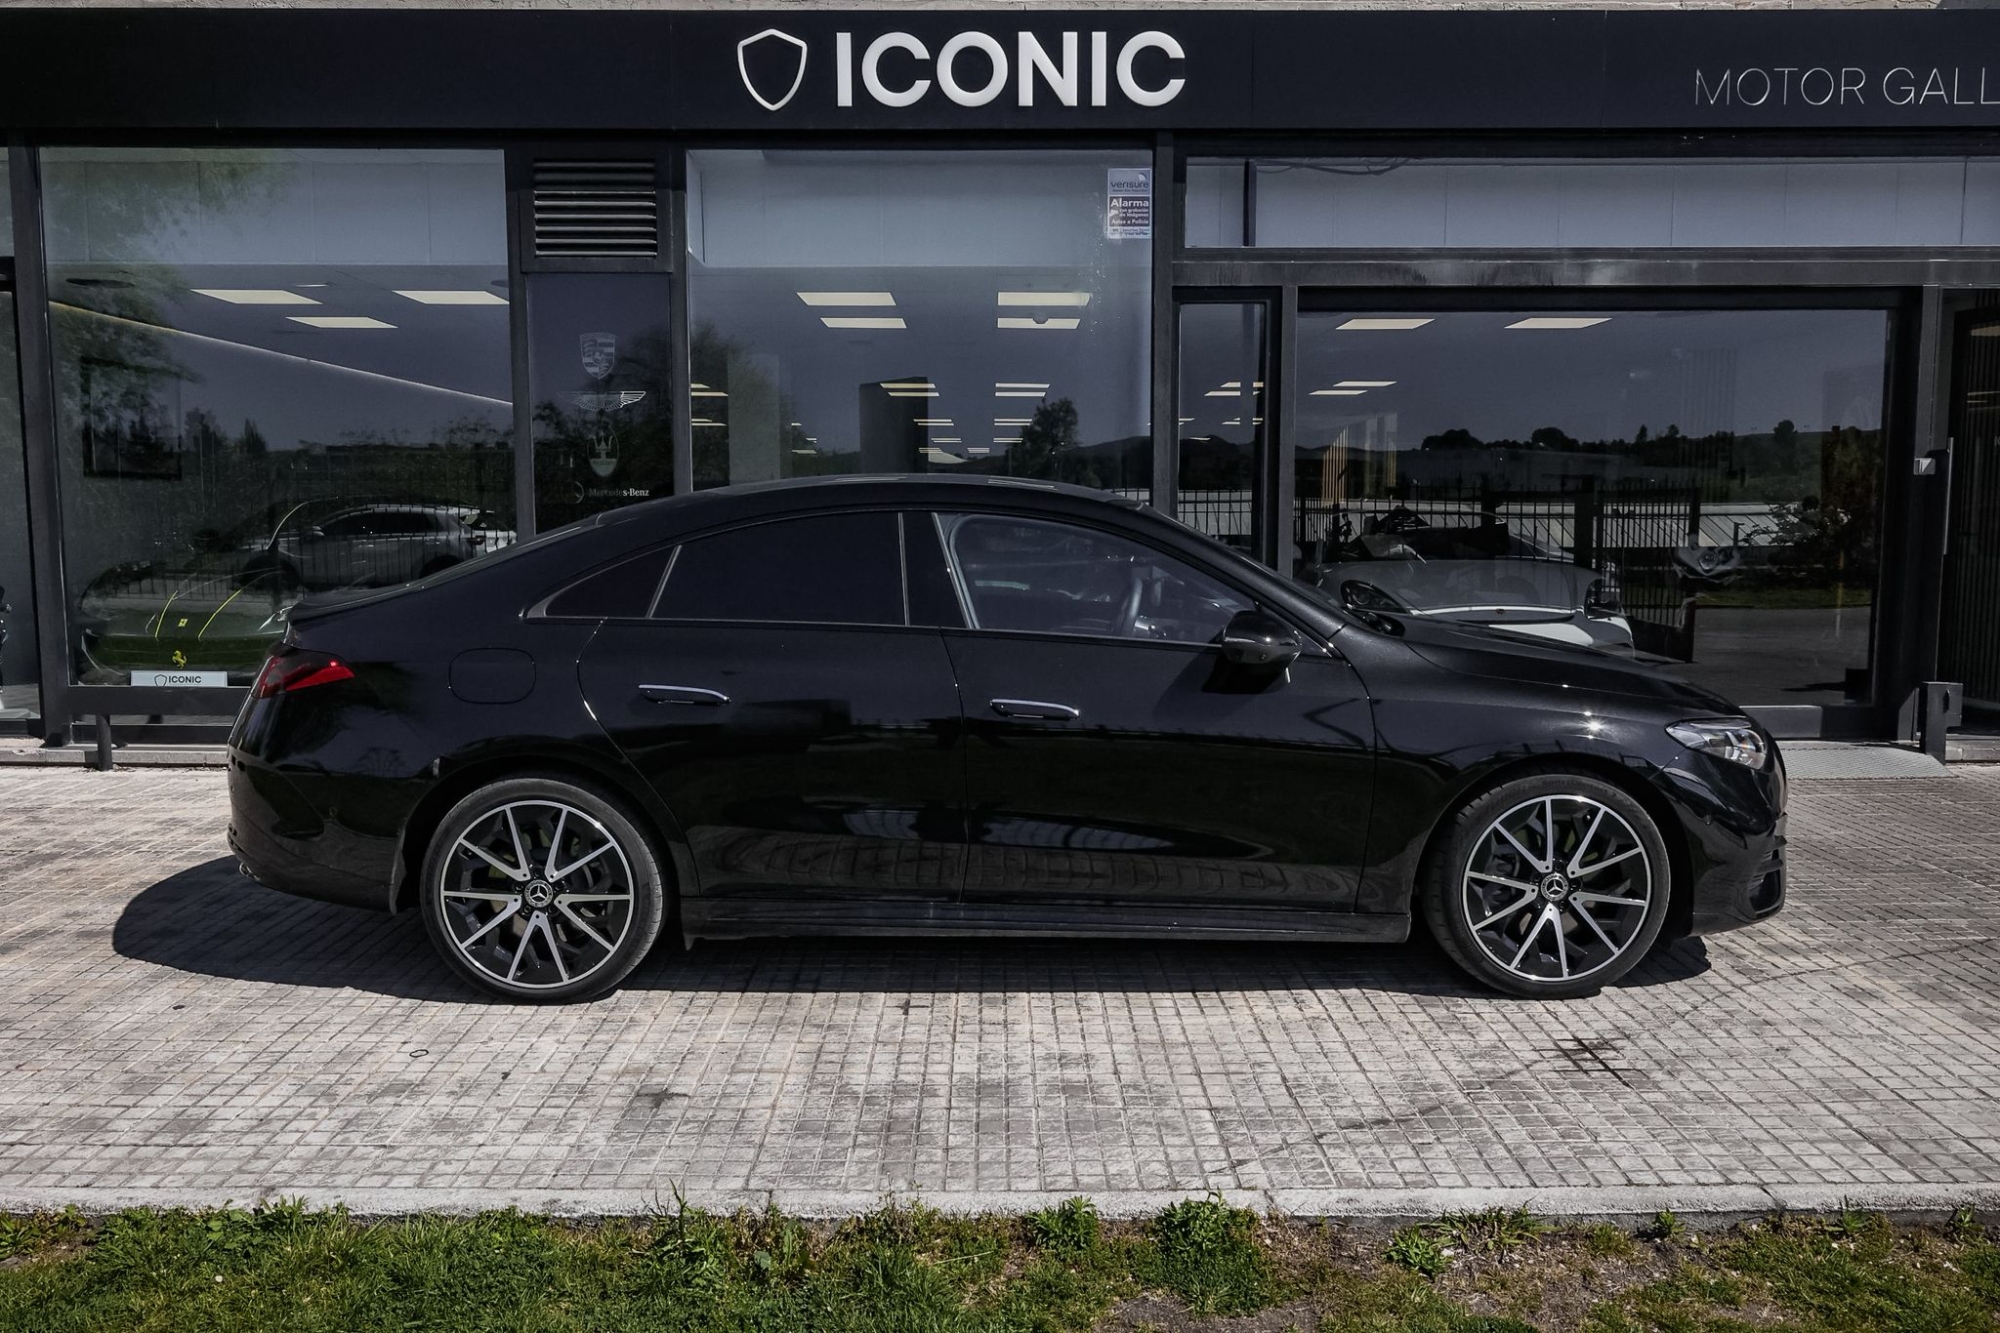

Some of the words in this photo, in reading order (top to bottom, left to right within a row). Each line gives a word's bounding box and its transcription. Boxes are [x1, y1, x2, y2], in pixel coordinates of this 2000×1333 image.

[836, 30, 1186, 108] ICONIC
[1694, 66, 1866, 106] MOTOR
[1882, 66, 2000, 106] GALL
[1110, 181, 1149, 189] verisure
[1110, 198, 1149, 207] Alarma
[168, 675, 202, 684] ICONIC
